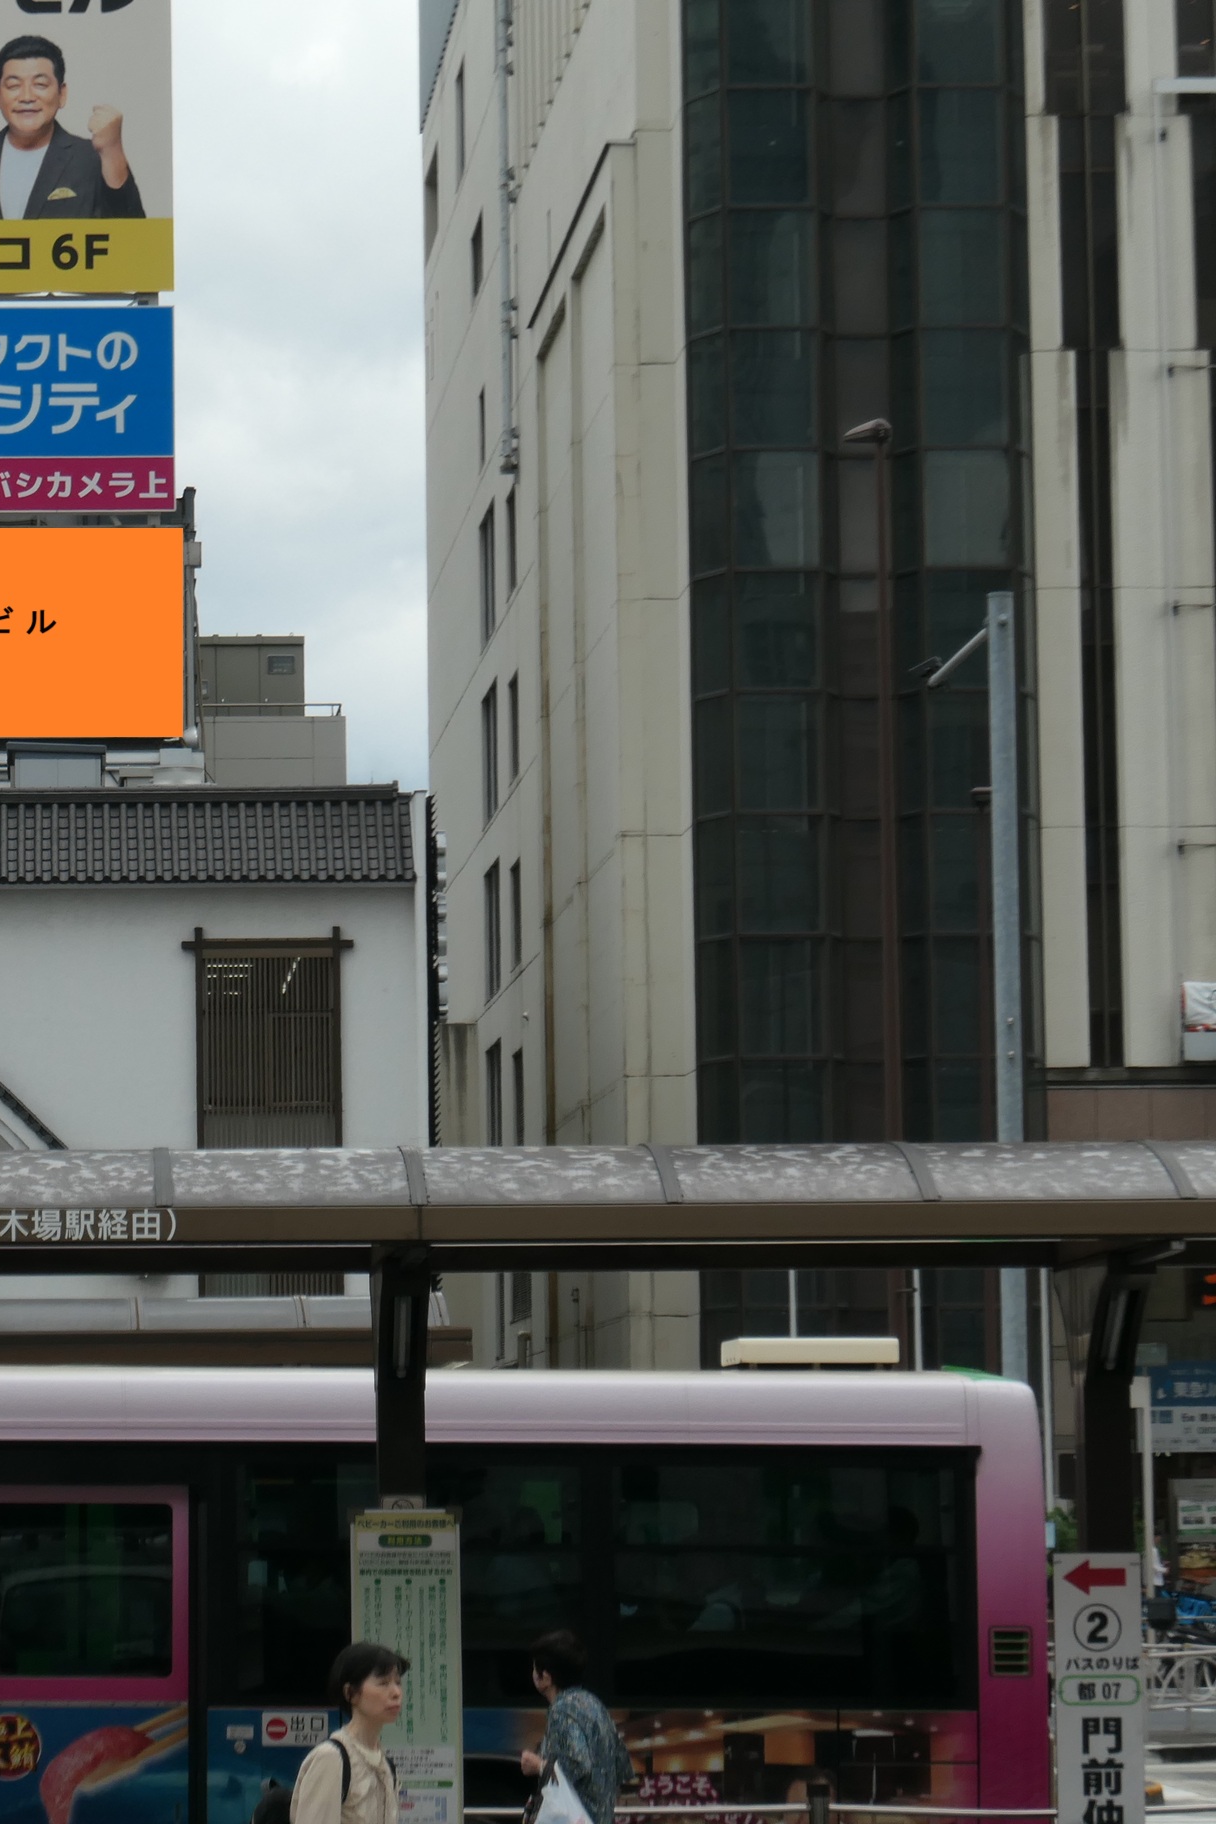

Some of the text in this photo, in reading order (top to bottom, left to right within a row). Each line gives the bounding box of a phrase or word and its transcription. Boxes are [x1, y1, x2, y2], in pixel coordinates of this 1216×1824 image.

[51, 233, 111, 271] 6F
[1065, 1656, 1140, 1671] バスのりば
[1101, 1682, 1122, 1701] 07
[290, 1714, 325, 1732] 出口
[294, 1733, 320, 1744] EXIT
